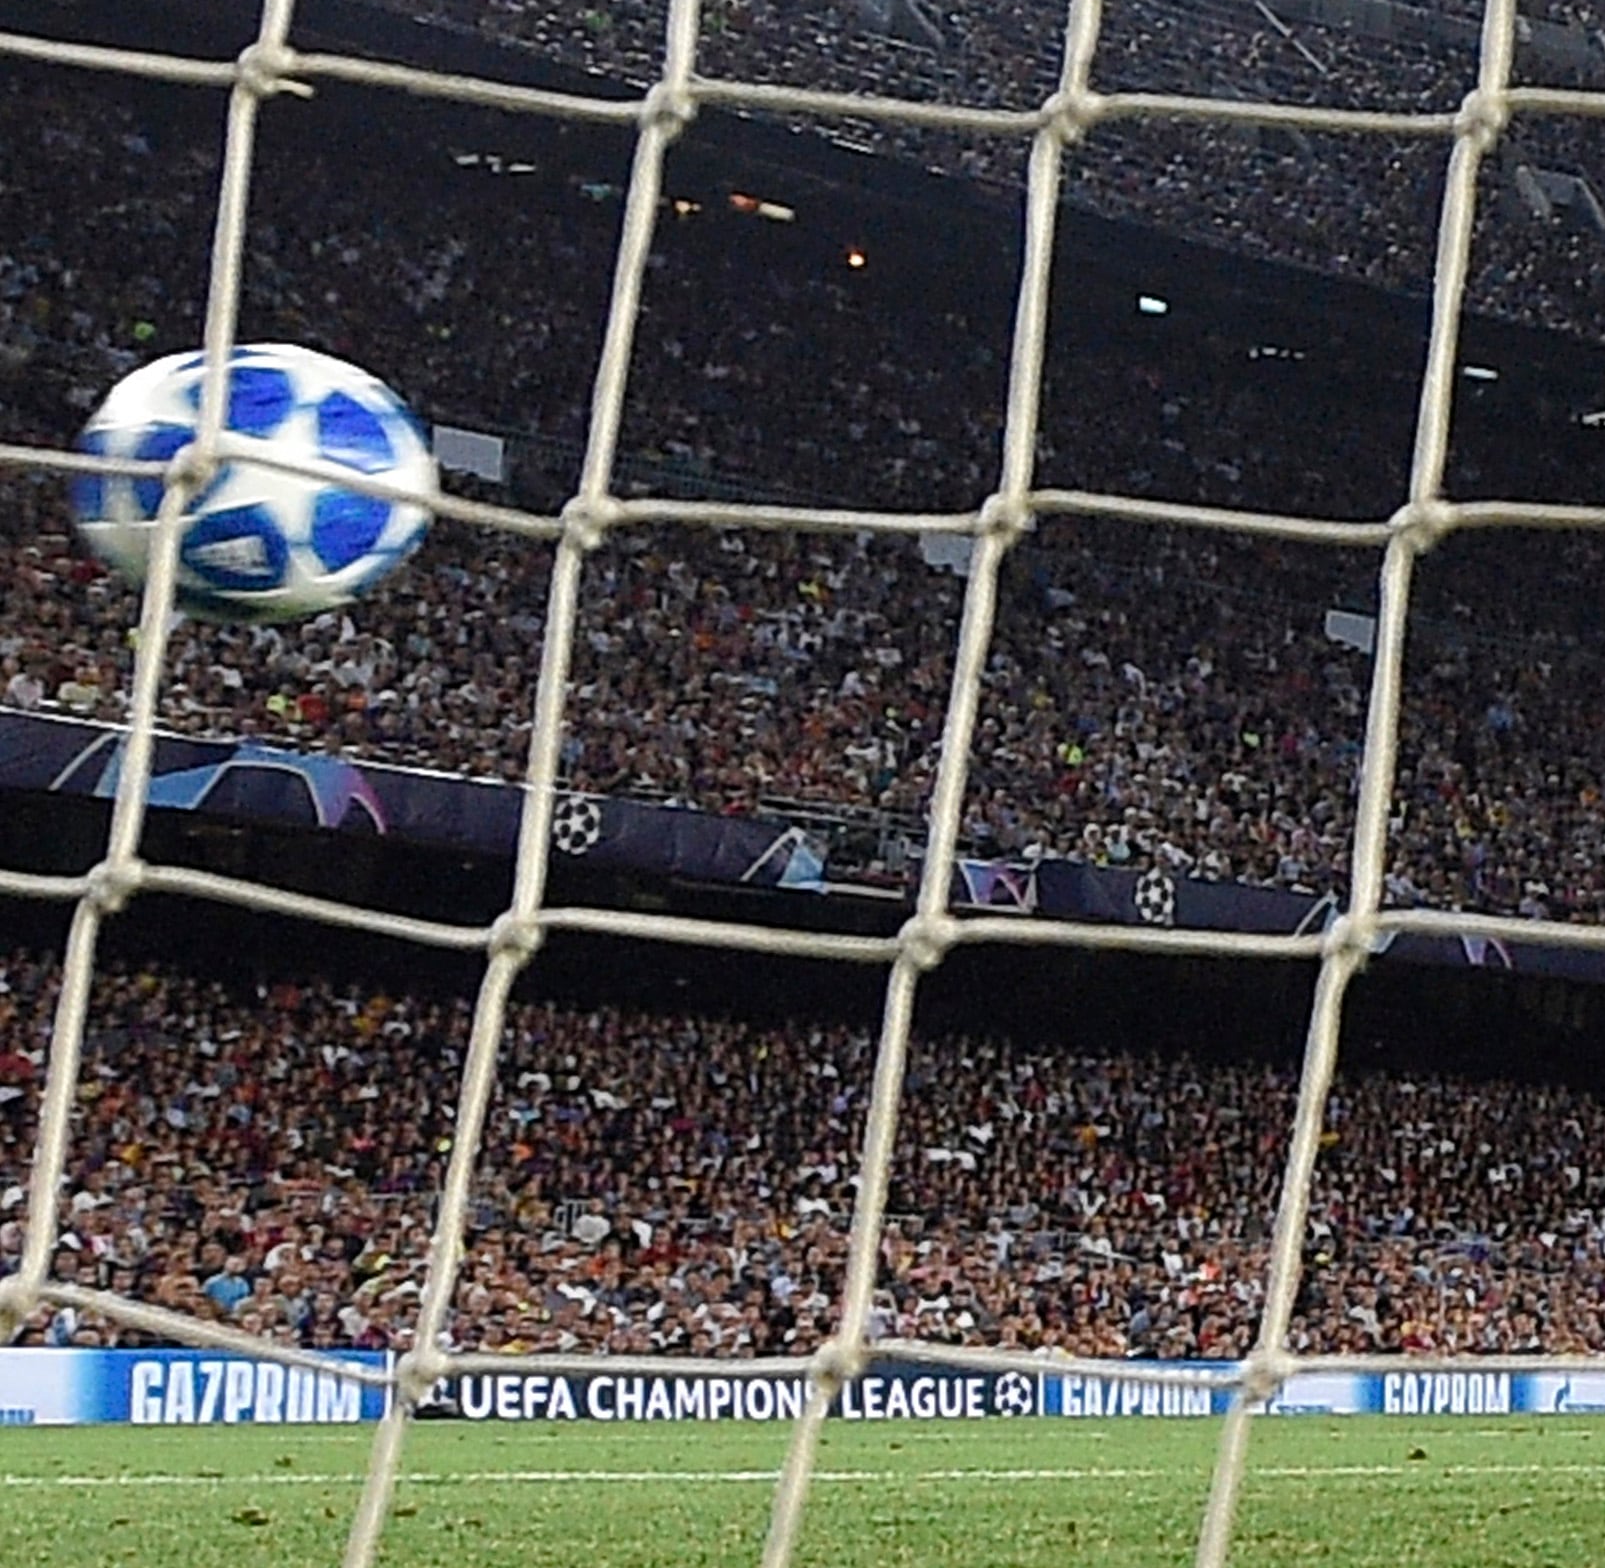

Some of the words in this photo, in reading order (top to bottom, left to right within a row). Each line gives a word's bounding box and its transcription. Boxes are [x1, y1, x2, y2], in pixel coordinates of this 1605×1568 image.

[131, 1361, 361, 1424] GAZPROM
[462, 1376, 576, 1419] UEFA
[842, 1377, 984, 1419] LEAGUE
[1384, 1373, 1510, 1414] GAZPROM
